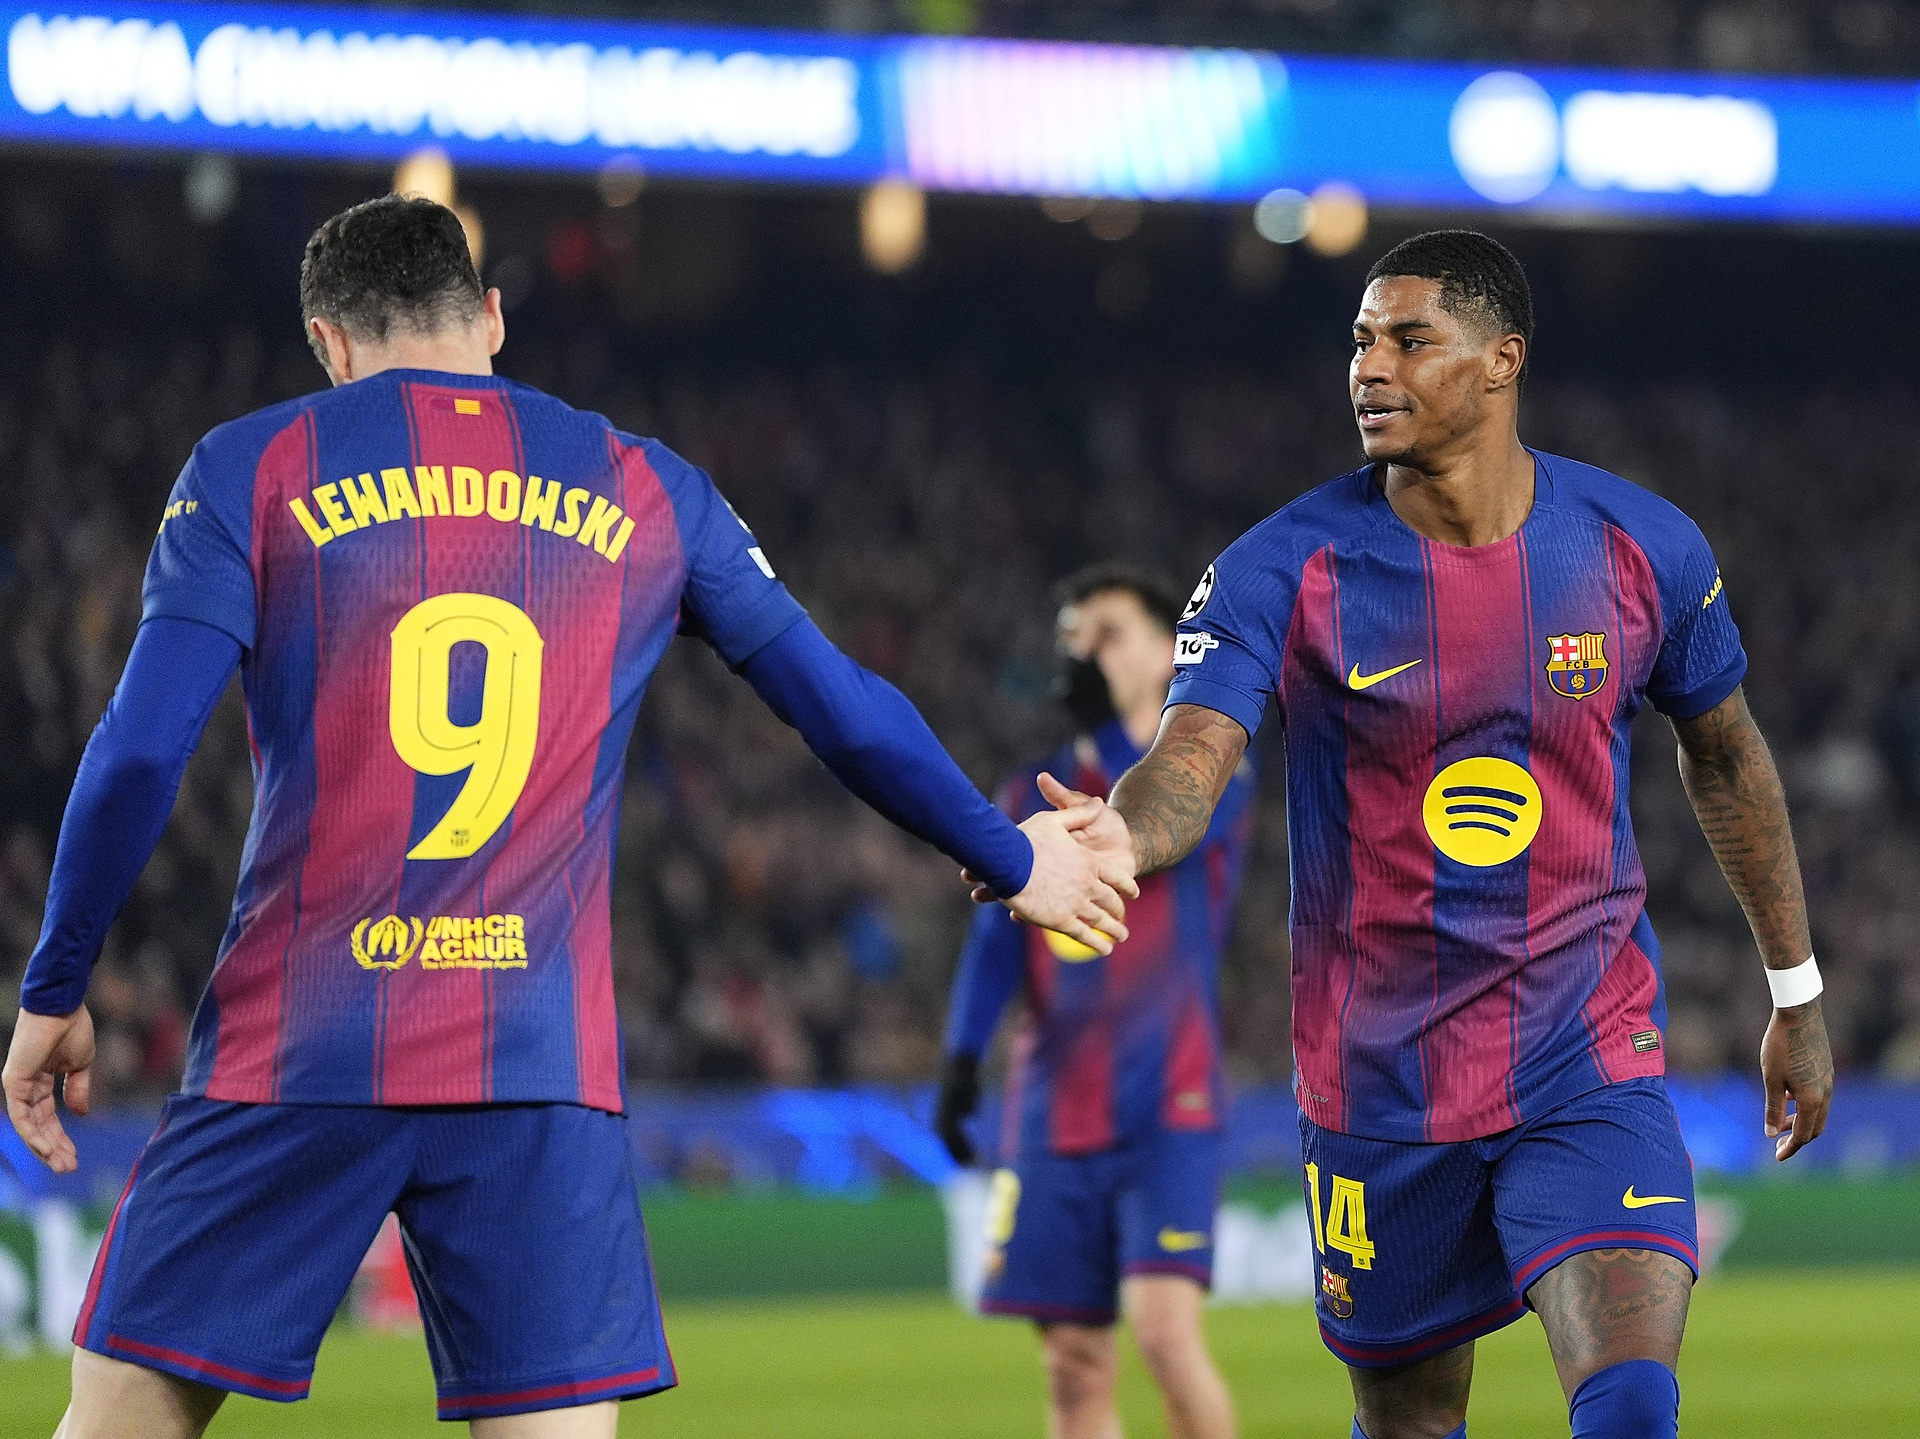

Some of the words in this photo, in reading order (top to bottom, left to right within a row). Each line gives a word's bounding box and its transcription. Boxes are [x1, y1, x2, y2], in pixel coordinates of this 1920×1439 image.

[289, 465, 636, 563] LEWANDOWSKI
[1180, 640, 1202, 655] 10
[389, 592, 545, 860] 9
[419, 936, 528, 960] ACNUR
[425, 914, 525, 940] UNHCR
[1305, 1161, 1375, 1270] 14
